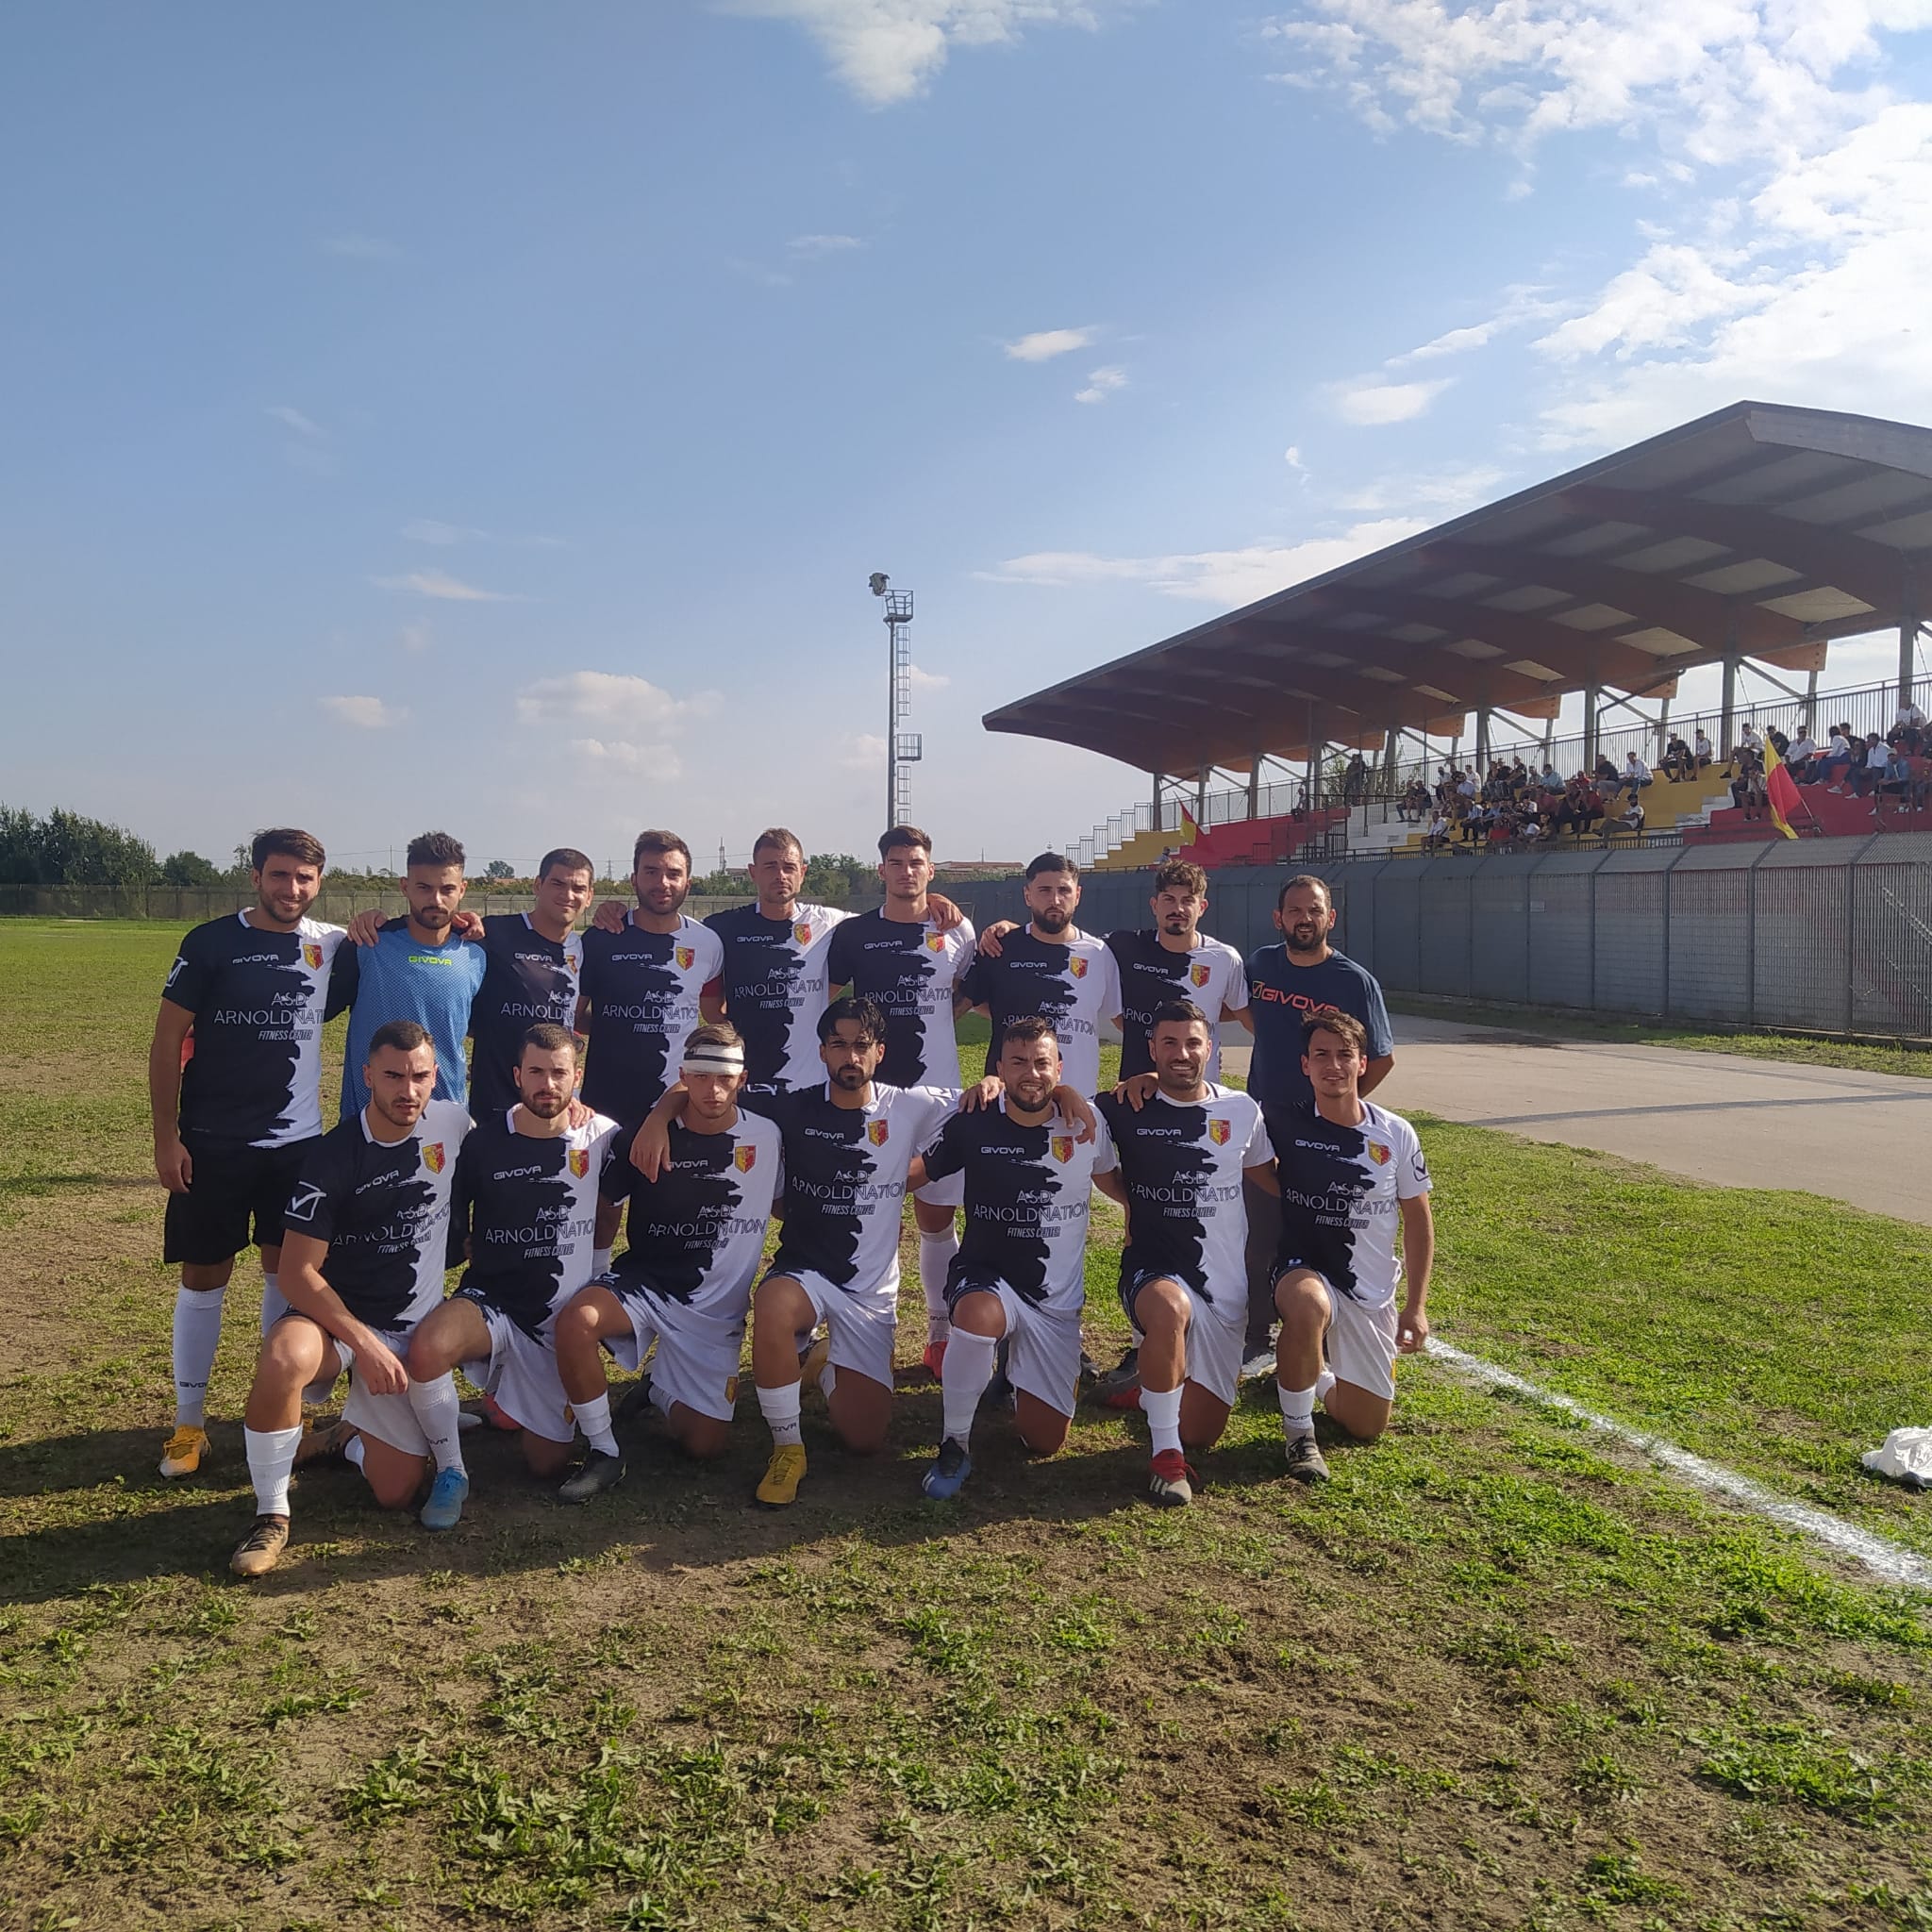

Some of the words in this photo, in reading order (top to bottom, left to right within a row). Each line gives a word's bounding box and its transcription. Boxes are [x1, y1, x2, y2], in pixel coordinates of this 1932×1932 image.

[863, 941, 903, 949] GIVOVA
[232, 954, 279, 964] GIVOVA
[408, 956, 453, 966] GIVOVA
[514, 953, 553, 962] GIVOVA
[1133, 963, 1169, 974] GIVOVA
[258, 1030, 289, 1041] FITNESS
[805, 1127, 844, 1141] GIVOVA
[981, 1146, 1024, 1155] GIVOVA
[1295, 1139, 1341, 1153] GIVOVA
[493, 1165, 542, 1180] GIVOVA
[822, 1204, 849, 1216] FITNESS
[1163, 1207, 1191, 1219] FITNESS
[1315, 1214, 1343, 1228] FITNESS
[1008, 1226, 1035, 1239] FITNESS
[524, 1244, 551, 1259] FITNESS
